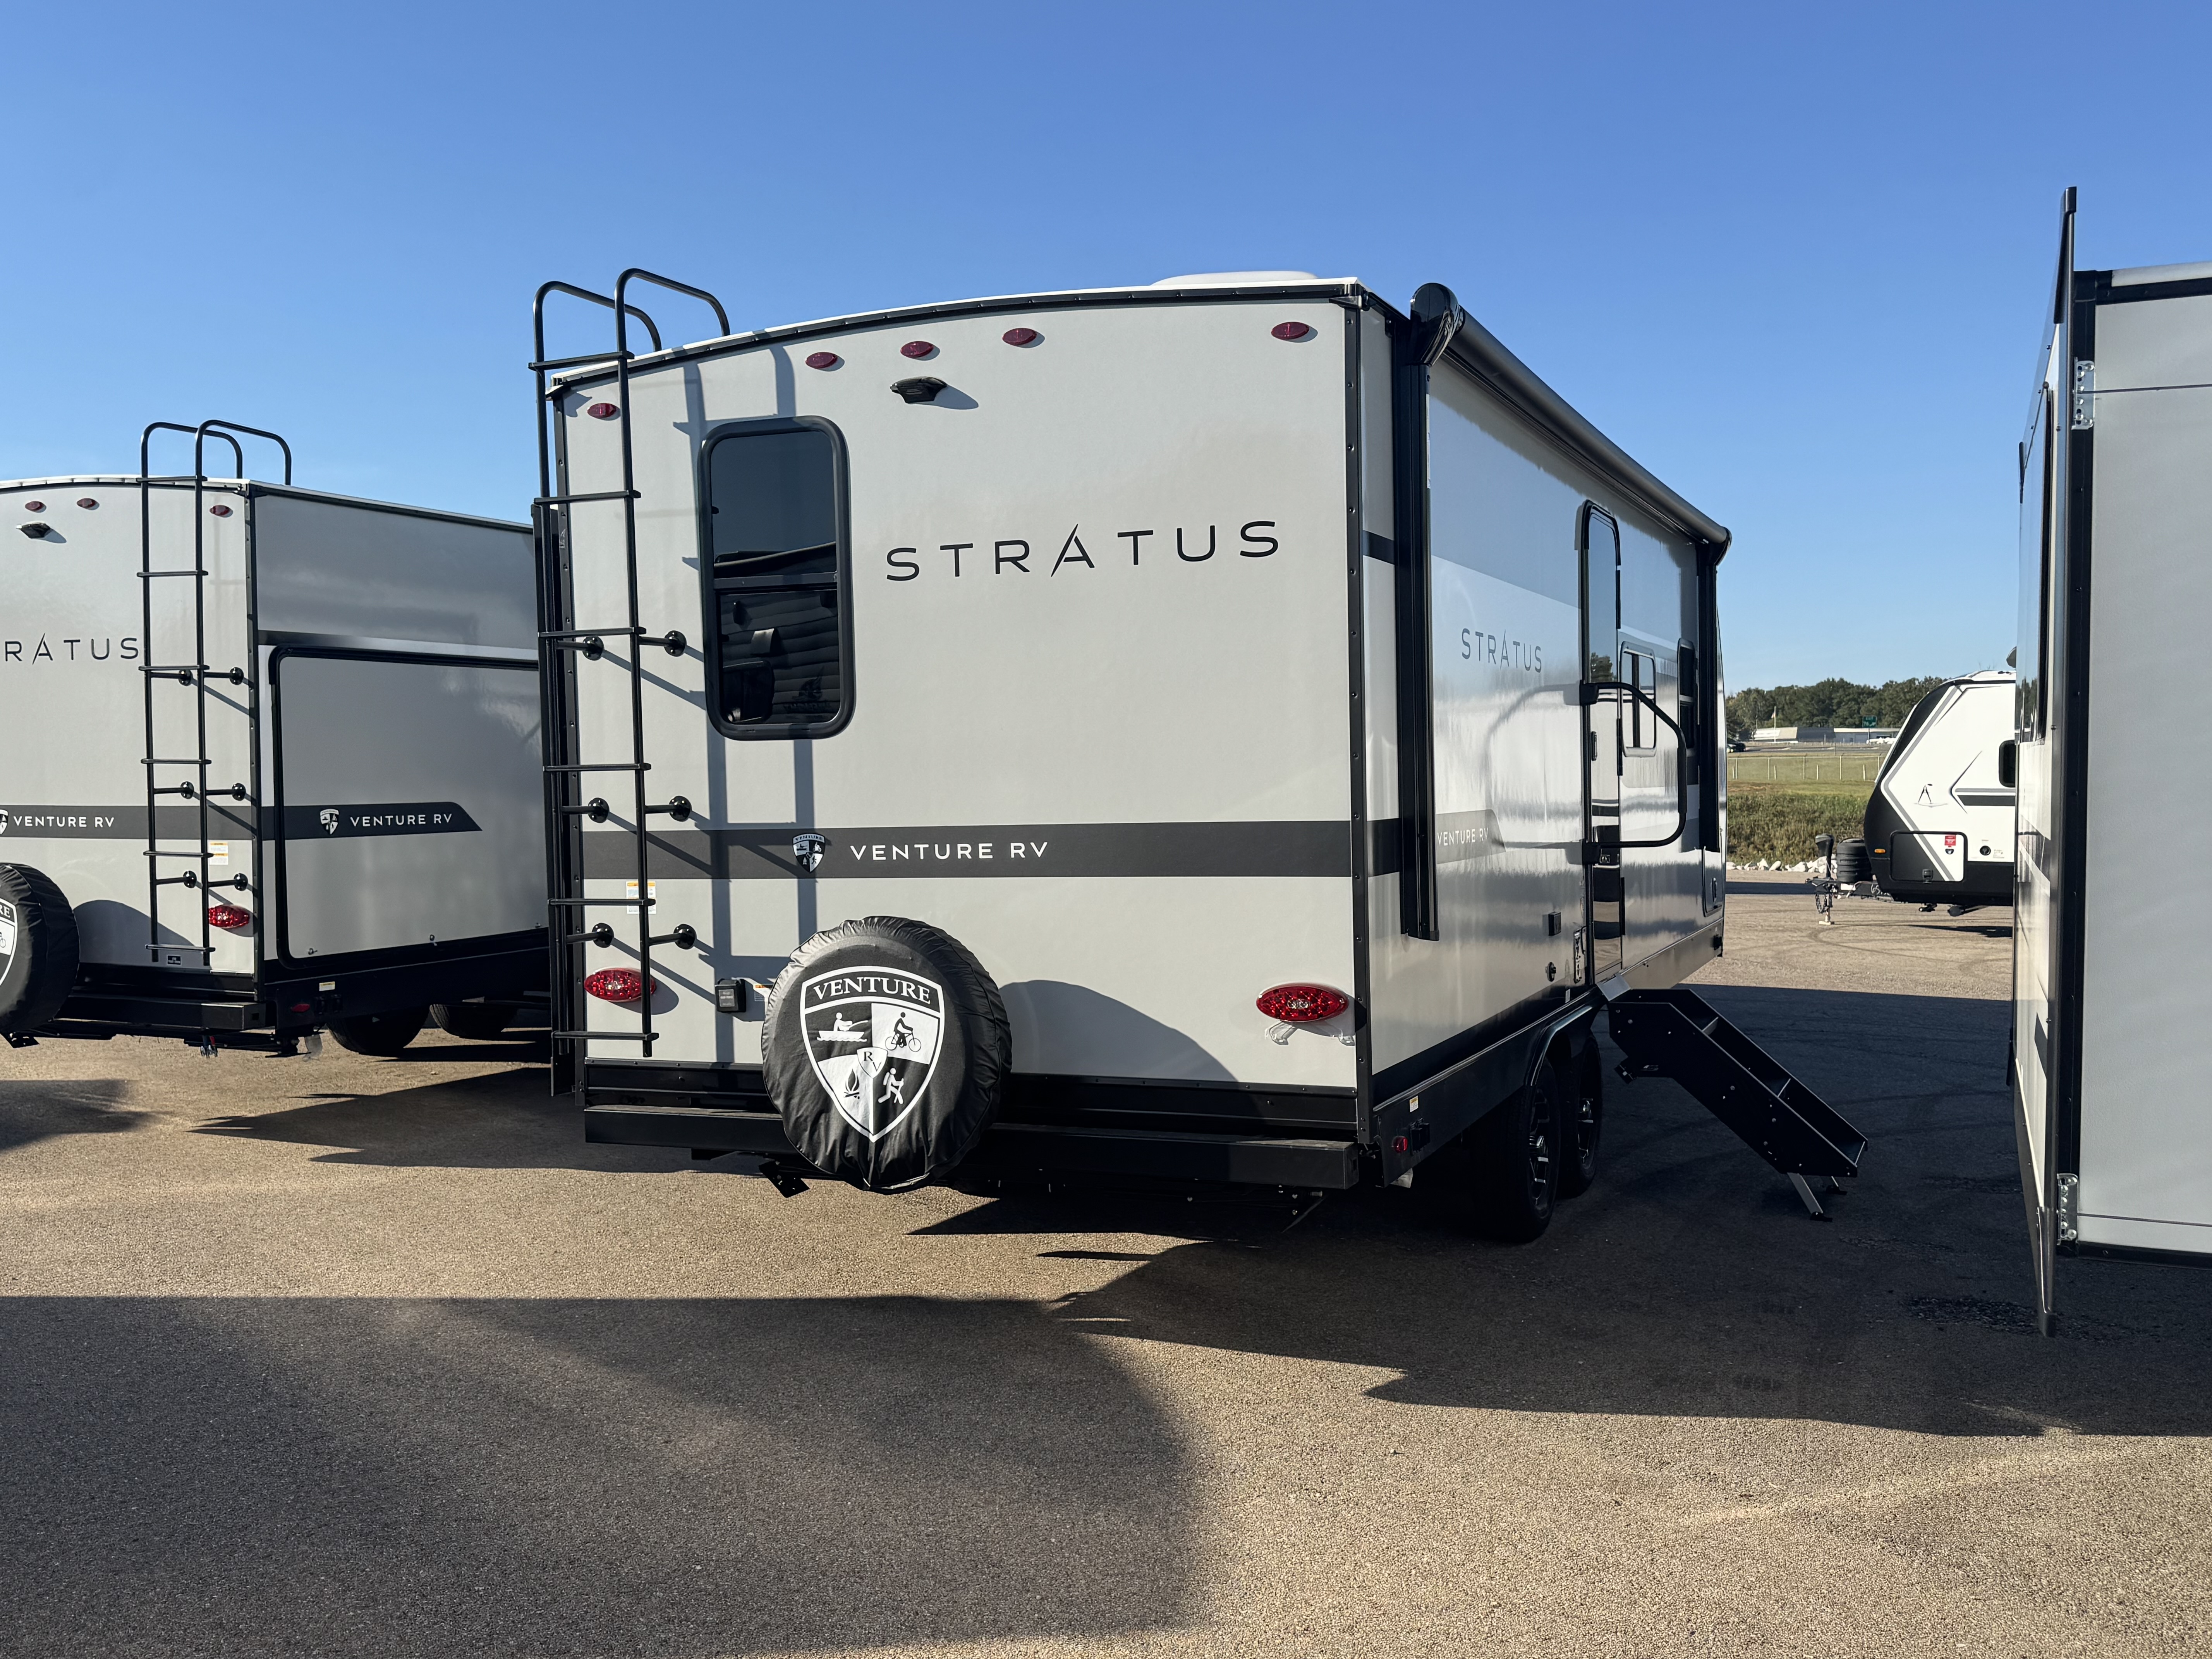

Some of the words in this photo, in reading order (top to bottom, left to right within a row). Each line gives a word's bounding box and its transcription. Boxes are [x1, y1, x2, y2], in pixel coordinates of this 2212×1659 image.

[886, 521, 1279, 581] STRATUS
[1462, 628, 1542, 673] STRATUS
[13, 816, 87, 827] VENTURE
[94, 817, 114, 828] RV
[350, 814, 426, 827] VENTURE
[434, 814, 452, 824] RV
[1437, 829, 1476, 846] VENTURE
[1479, 828, 1488, 842] RV
[850, 843, 993, 860] VENTURE
[1010, 842, 1048, 858] RV
[813, 977, 931, 1005] VENTURE
